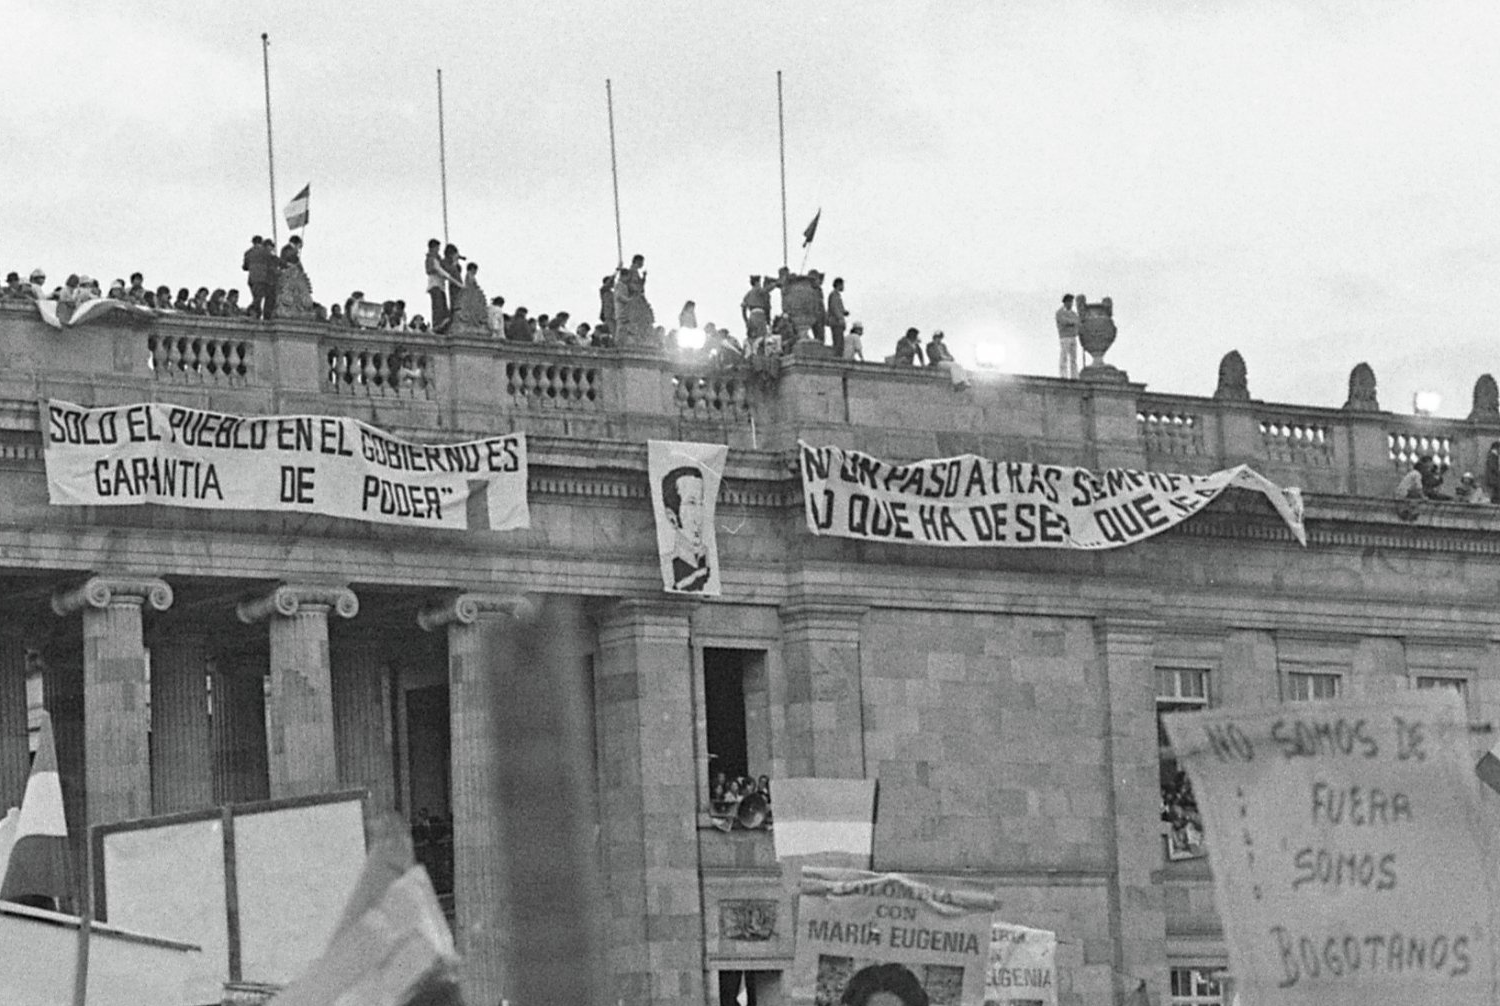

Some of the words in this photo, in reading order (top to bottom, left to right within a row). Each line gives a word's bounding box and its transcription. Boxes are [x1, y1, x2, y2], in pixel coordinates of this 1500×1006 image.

[50, 406, 118, 445] SOLO
[127, 405, 161, 442] EL
[169, 408, 267, 450] PUEBLO
[277, 418, 313, 452] EN
[320, 418, 353, 457] EL
[360, 427, 480, 473] GOBIERNO
[486, 438, 519, 472] ES
[95, 456, 224, 500] GARANTIA
[280, 465, 315, 504] DE
[849, 493, 914, 540] QUE
[918, 503, 967, 542] HA
[969, 502, 1008, 541] DE
[1093, 493, 1170, 542] QUE
[1271, 718, 1379, 759] SOMOS
[1312, 782, 1412, 826] FUERA
[1291, 848, 1397, 892] SOMOS
[876, 904, 918, 921] CON
[807, 918, 881, 946] MARIA
[889, 926, 980, 956] EUGENIA
[986, 967, 1052, 989] UGENIA
